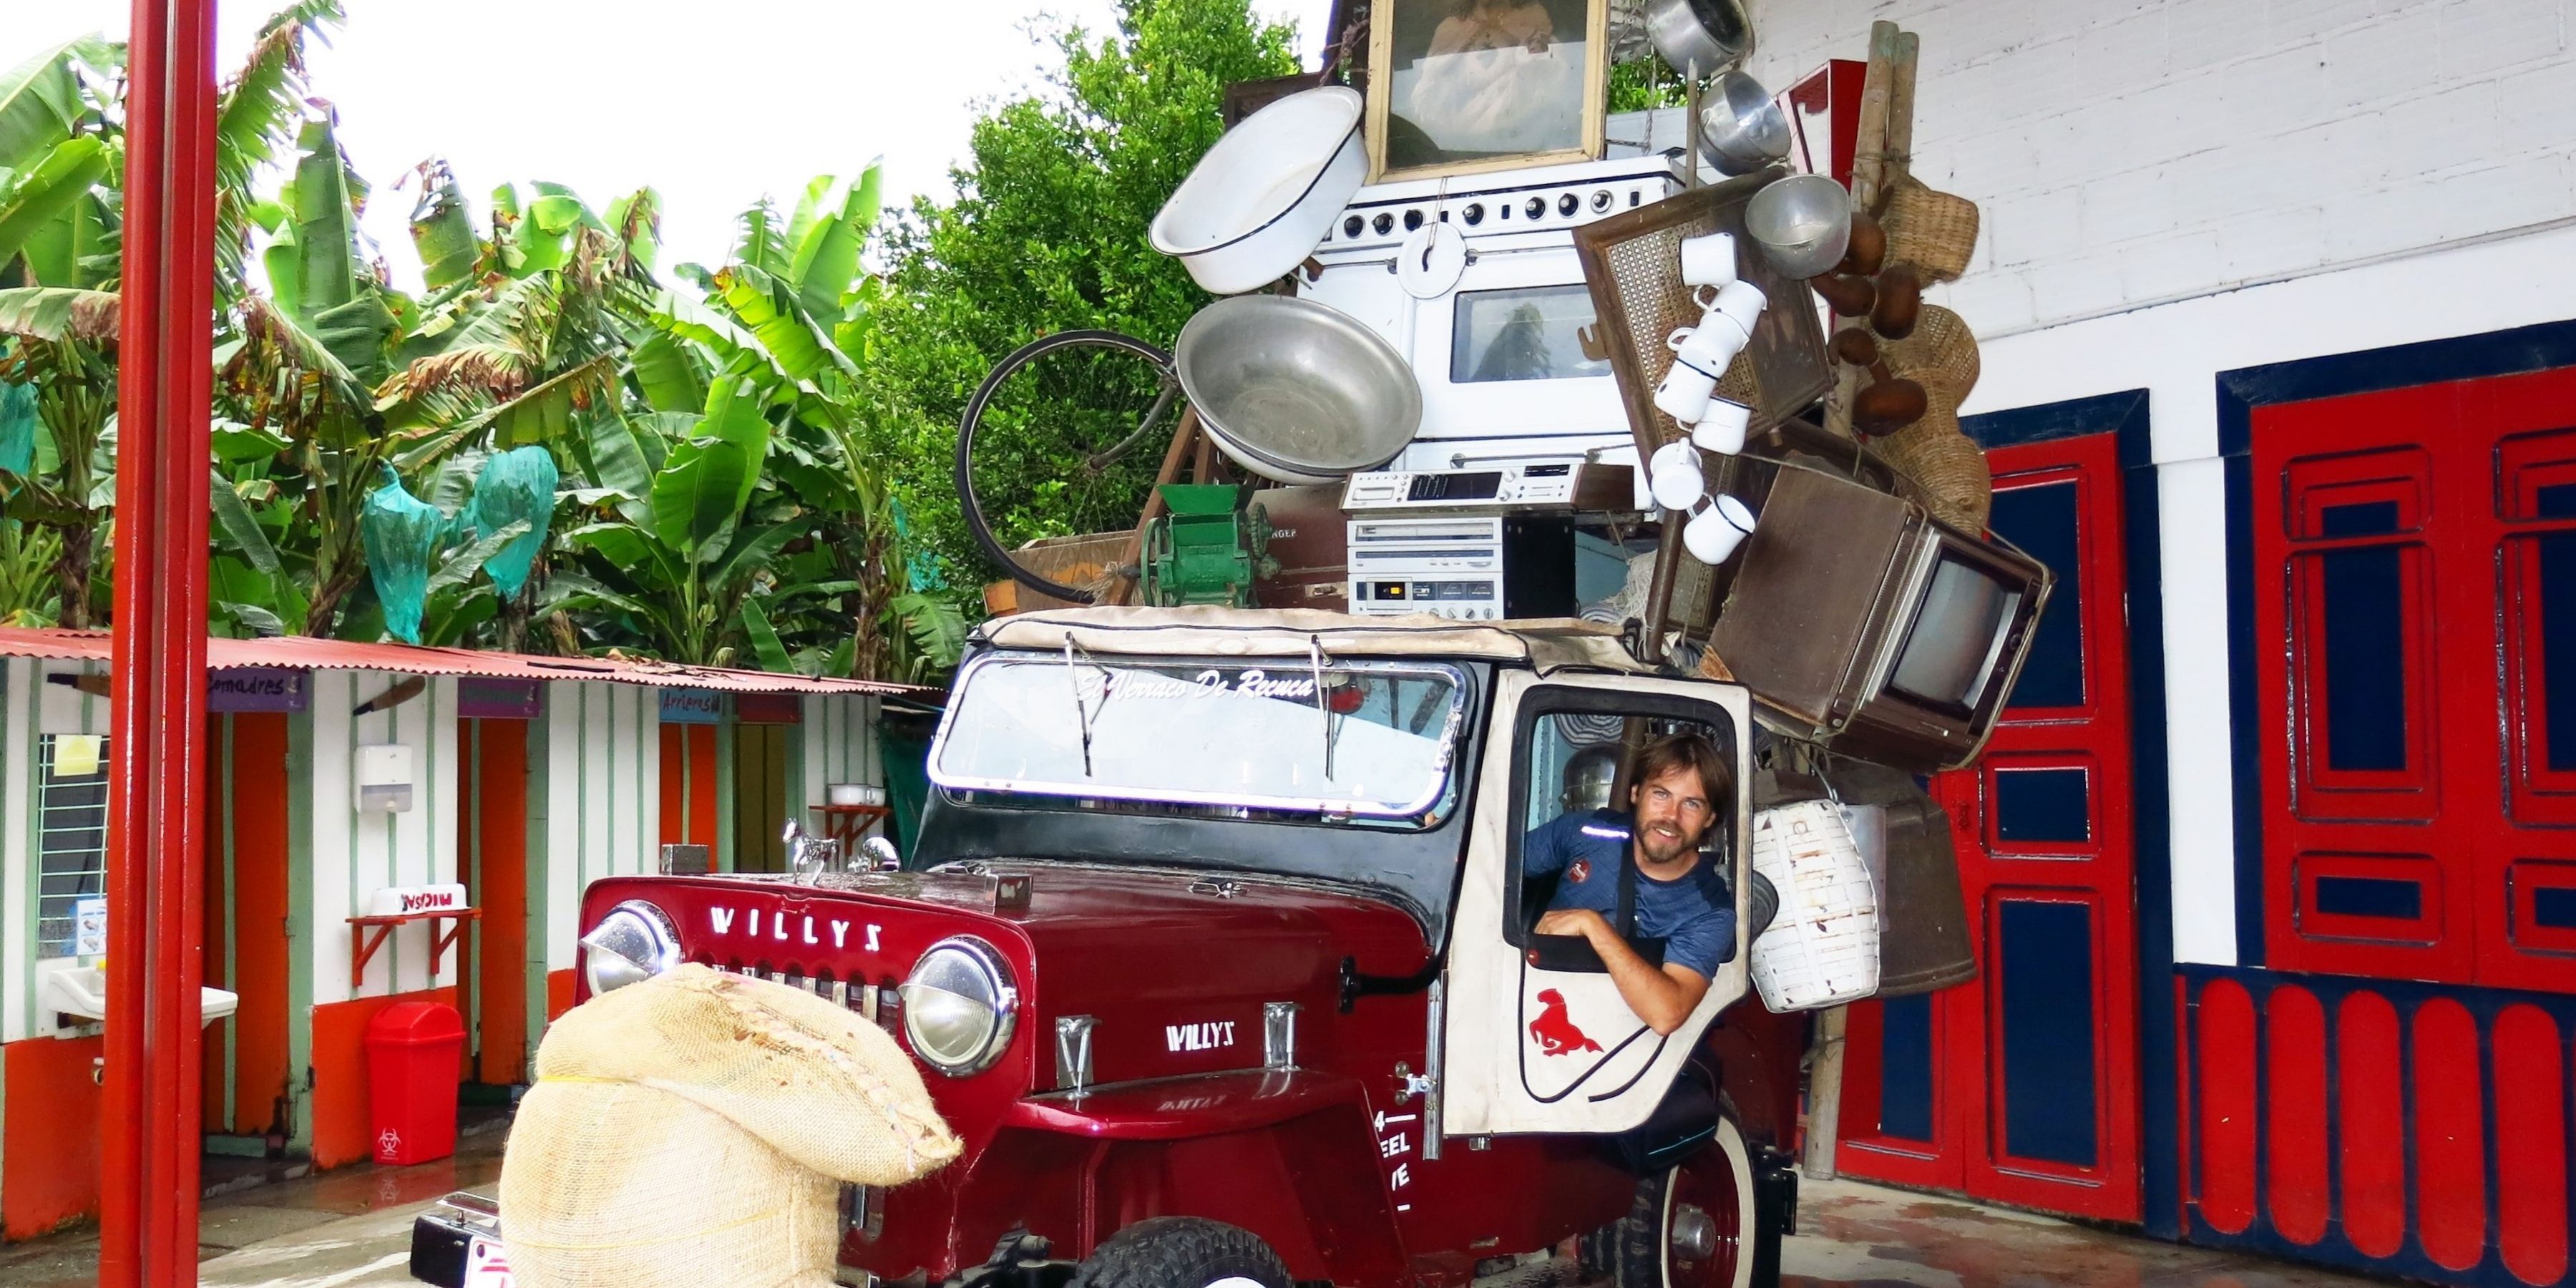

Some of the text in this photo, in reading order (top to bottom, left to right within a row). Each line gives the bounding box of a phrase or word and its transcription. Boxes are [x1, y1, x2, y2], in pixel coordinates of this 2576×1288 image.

[1108, 670, 1188, 701] Verraco
[1194, 669, 1229, 698] De
[1233, 670, 1314, 699] Recuca
[663, 691, 711, 712] Arrieros
[711, 907, 882, 952] WILLYS
[1166, 1021, 1234, 1052] WILLYS
[1380, 1132, 1410, 1158] EEL
